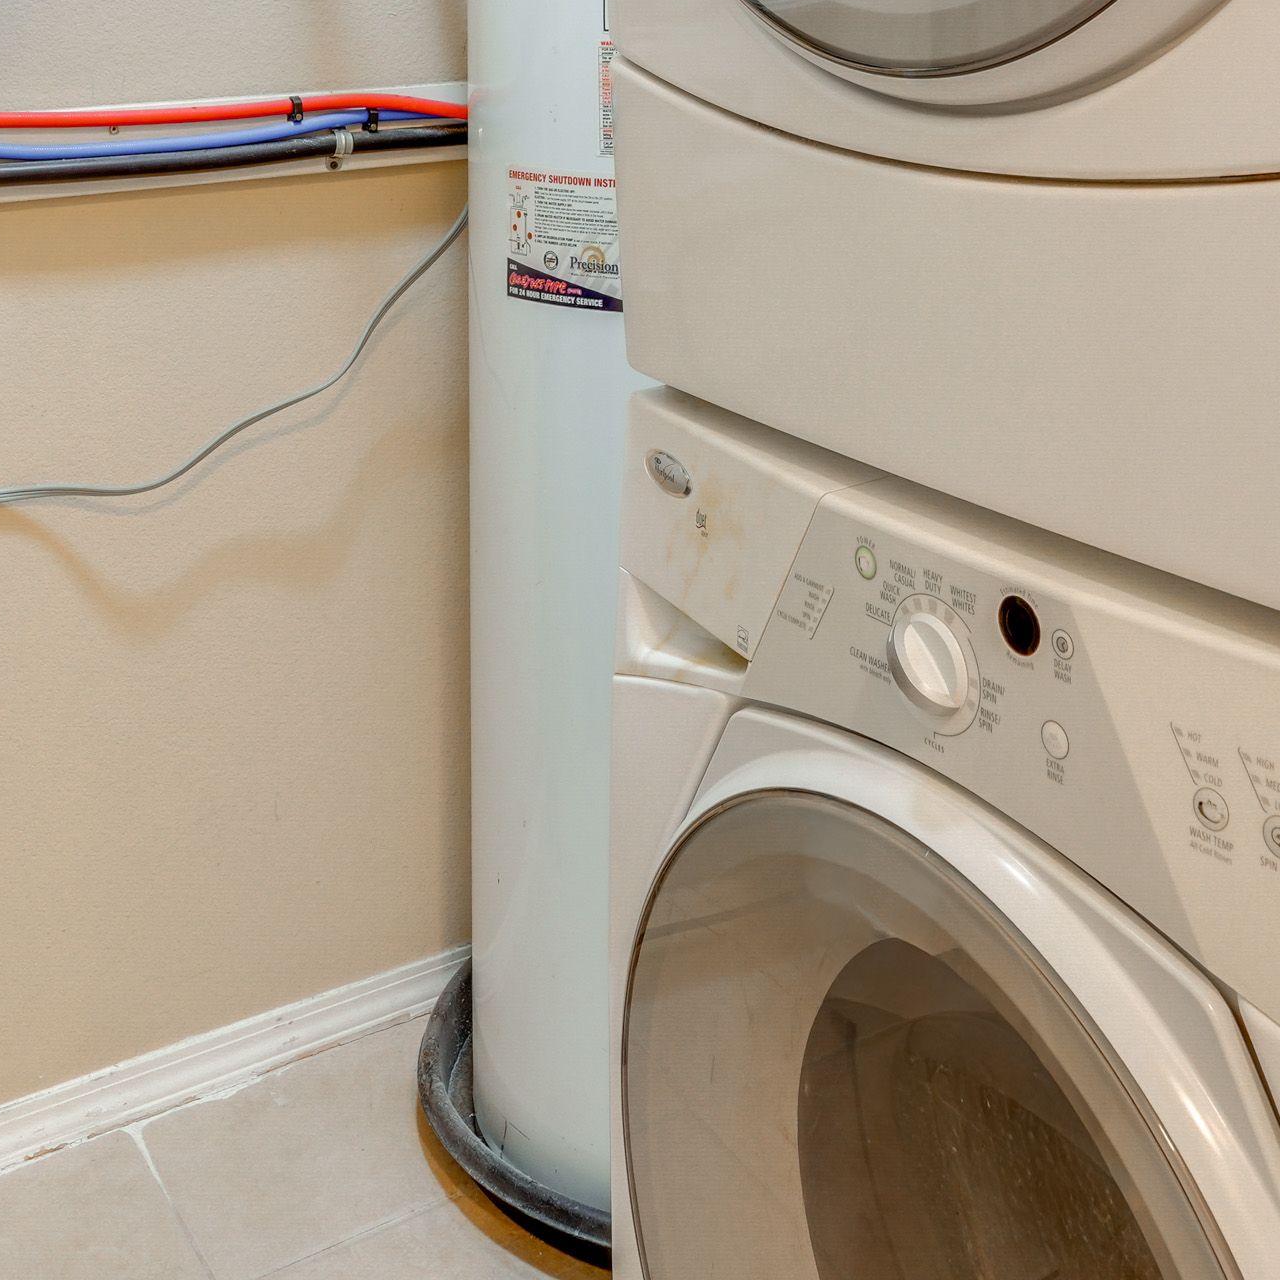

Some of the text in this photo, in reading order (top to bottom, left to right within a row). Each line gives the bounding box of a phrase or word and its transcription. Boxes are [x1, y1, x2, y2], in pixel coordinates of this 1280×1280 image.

[509, 170, 547, 183] EMERGENCY
[548, 174, 591, 186] SHUTDOWN
[569, 256, 619, 272] Precision
[509, 286, 518, 294] FOR
[540, 292, 576, 304] EMERGENCY
[576, 297, 603, 307] SERVICE
[889, 559, 917, 579] NORMAL/
[922, 568, 943, 584] HEAVY
[882, 580, 900, 596] QUICK
[893, 572, 915, 590] CASUAL
[924, 580, 941, 595] DUTY
[880, 590, 896, 605] WASH
[950, 584, 976, 604] WHITEST
[865, 602, 891, 622] DELICATE
[951, 597, 975, 616] WHITES
[849, 645, 867, 662] CLEAN
[1053, 658, 1072, 674] DELAY
[1053, 669, 1072, 685] WASH
[982, 677, 1005, 696] DRAIN/
[982, 688, 997, 705] SPIN
[980, 706, 1001, 725] RINSE/
[978, 717, 993, 733] SPIN
[924, 737, 945, 754] CYCLES
[1187, 732, 1202, 744] HOT
[1046, 757, 1065, 775] EXTRA
[1195, 751, 1219, 769] WARM
[1256, 756, 1275, 770] HIGH
[1047, 768, 1064, 785] RINSE
[1203, 772, 1223, 787] COLD
[1189, 825, 1234, 852] WASH TEMP
[1260, 855, 1278, 872] SPIN
